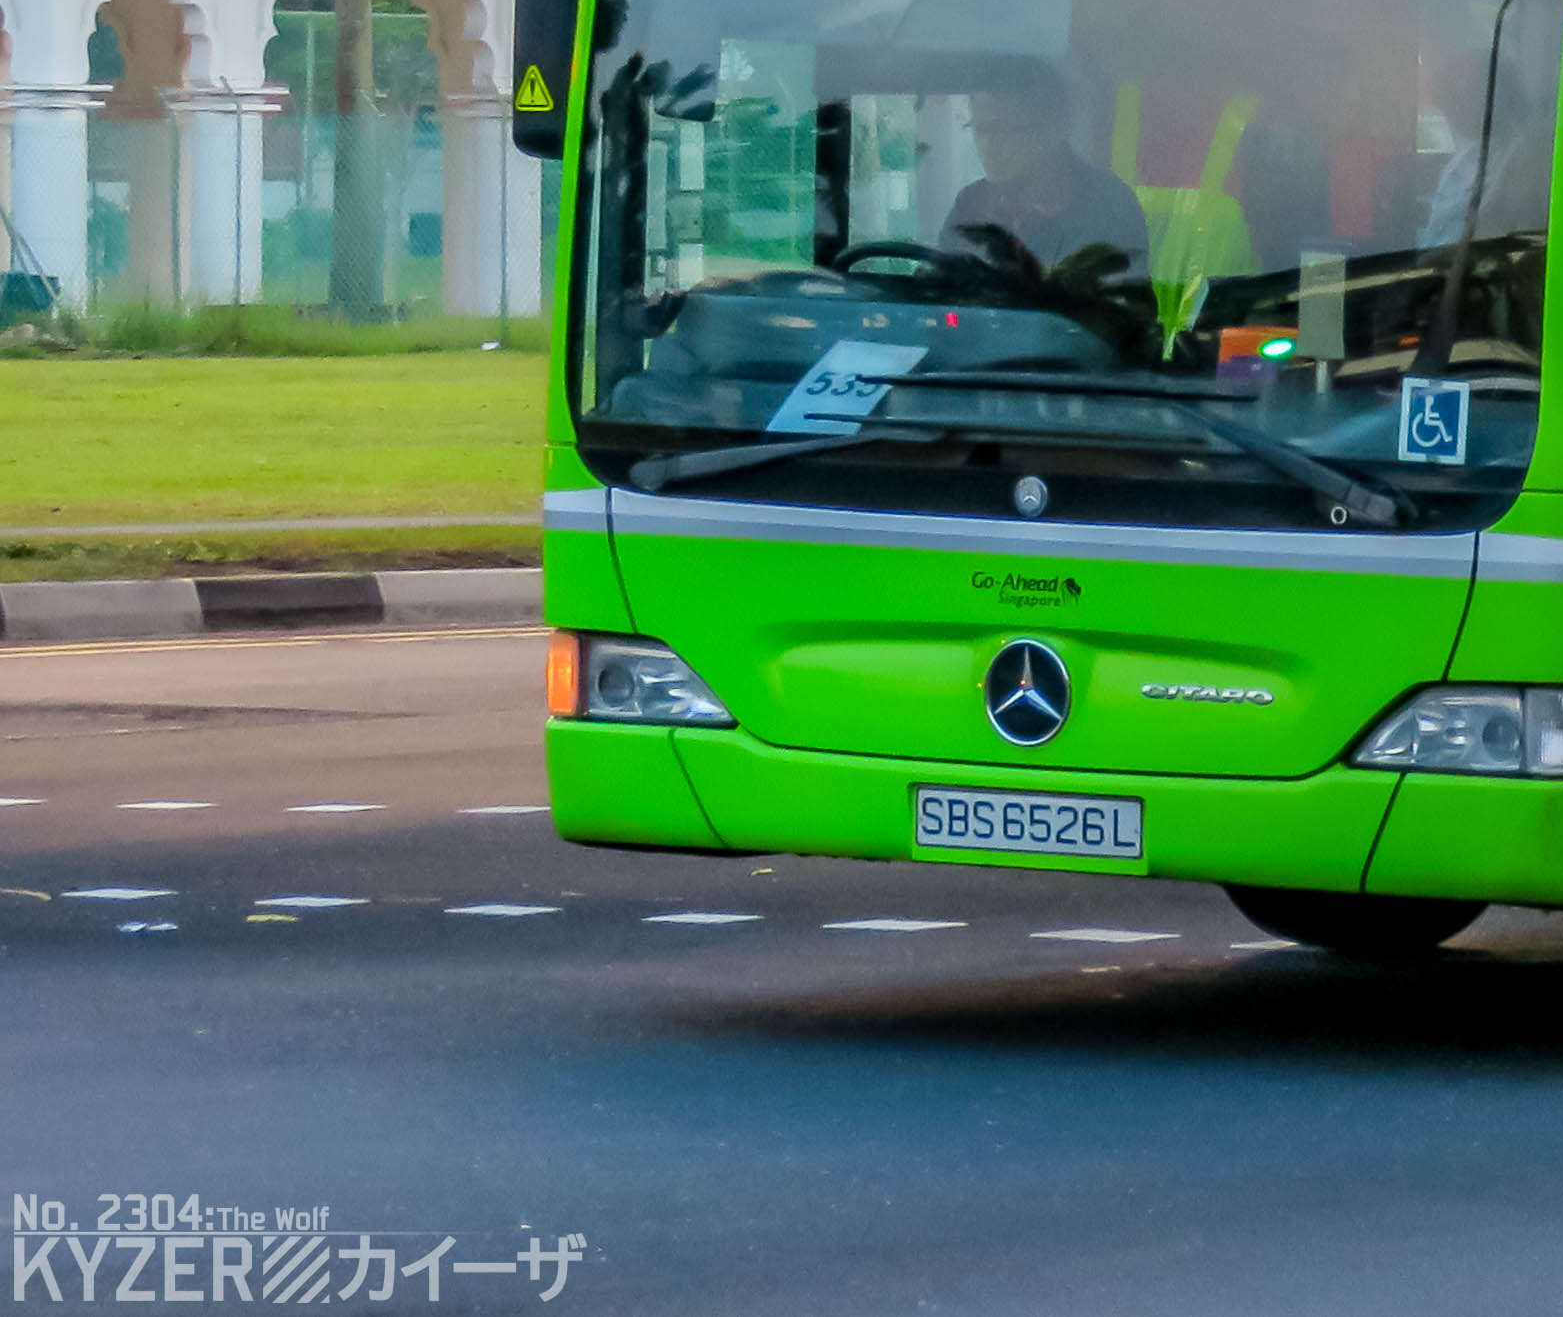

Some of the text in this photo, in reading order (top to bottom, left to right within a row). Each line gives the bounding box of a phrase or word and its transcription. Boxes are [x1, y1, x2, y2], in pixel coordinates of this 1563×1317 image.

[971, 571, 1060, 592] Go-Ahead
[1141, 682, 1275, 706] CITARO
[921, 796, 1137, 848] SBS6526L
